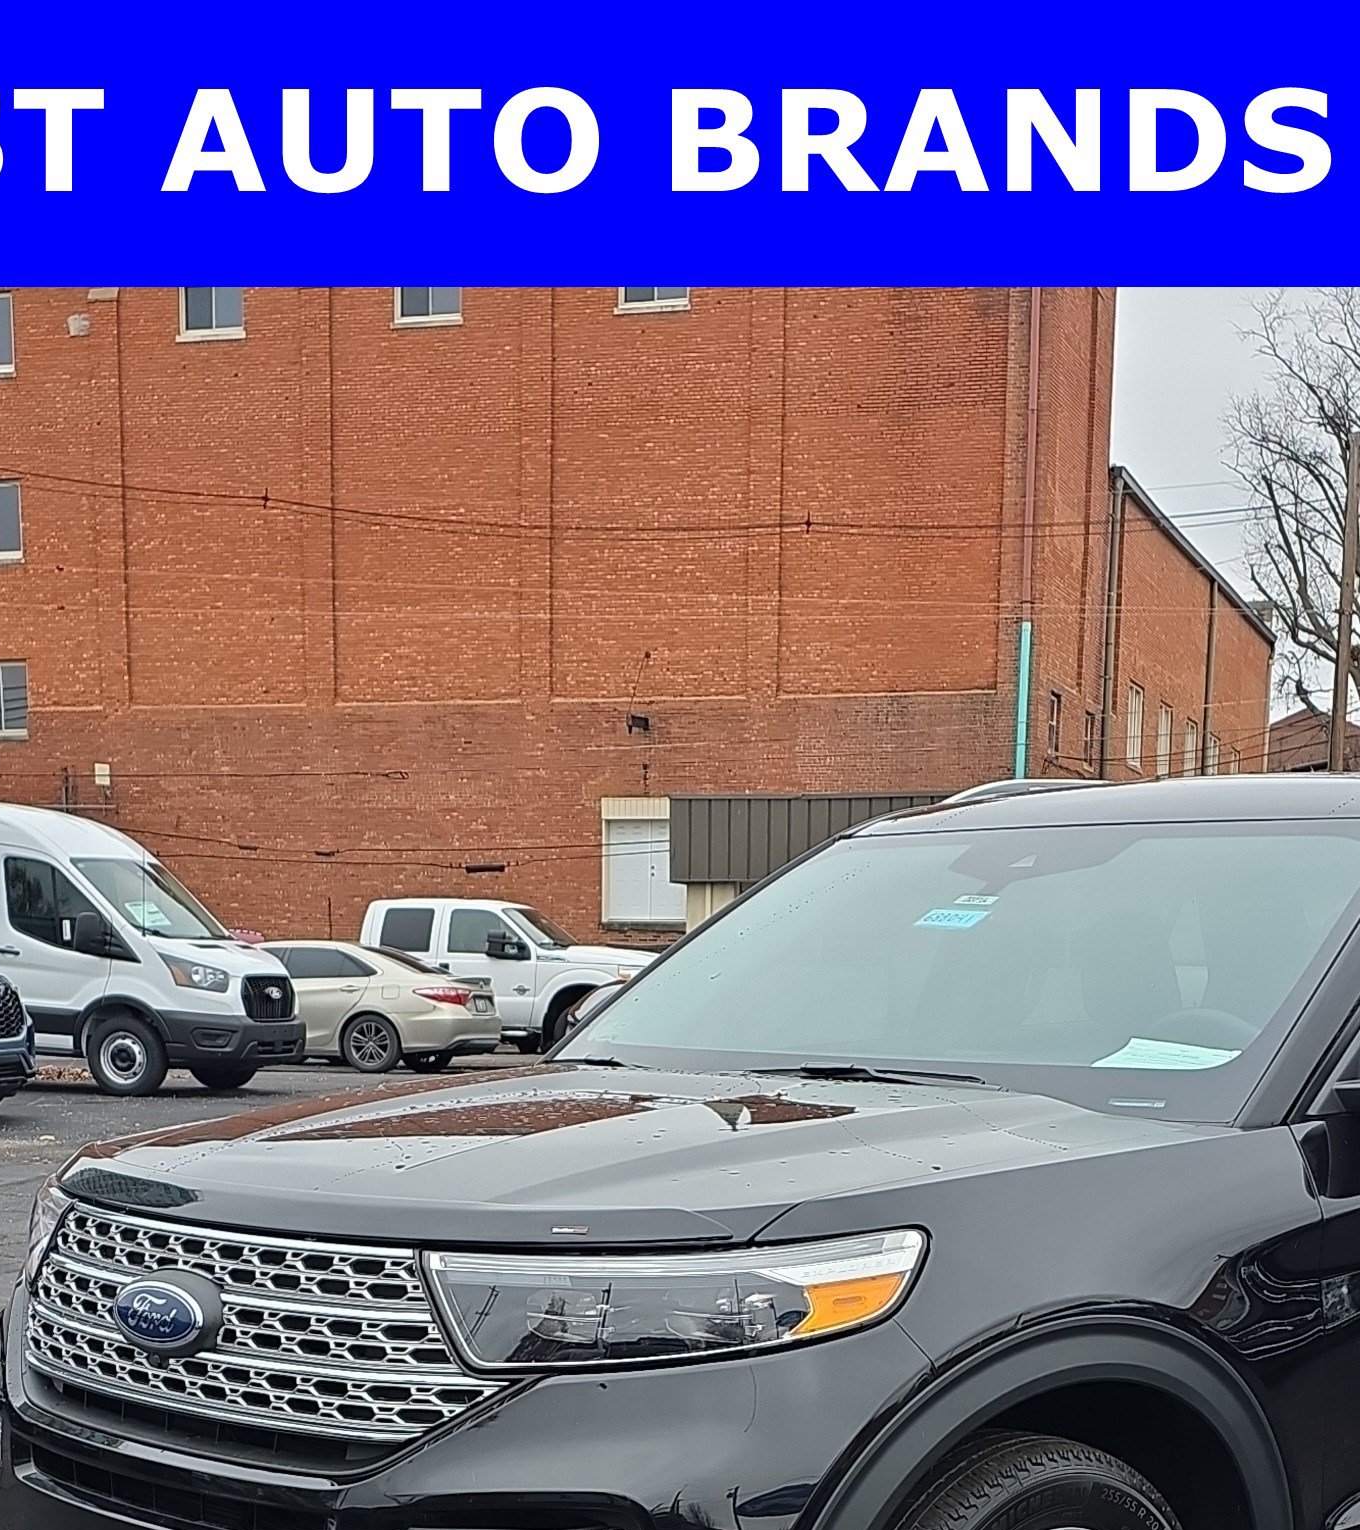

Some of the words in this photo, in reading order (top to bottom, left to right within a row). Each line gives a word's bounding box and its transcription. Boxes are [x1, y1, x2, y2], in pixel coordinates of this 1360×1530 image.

[128, 1292, 178, 1333] Ford
[1101, 1488, 1138, 1512] 255/55
[1137, 1506, 1147, 1520] R
[1146, 1515, 1159, 1530] 20
